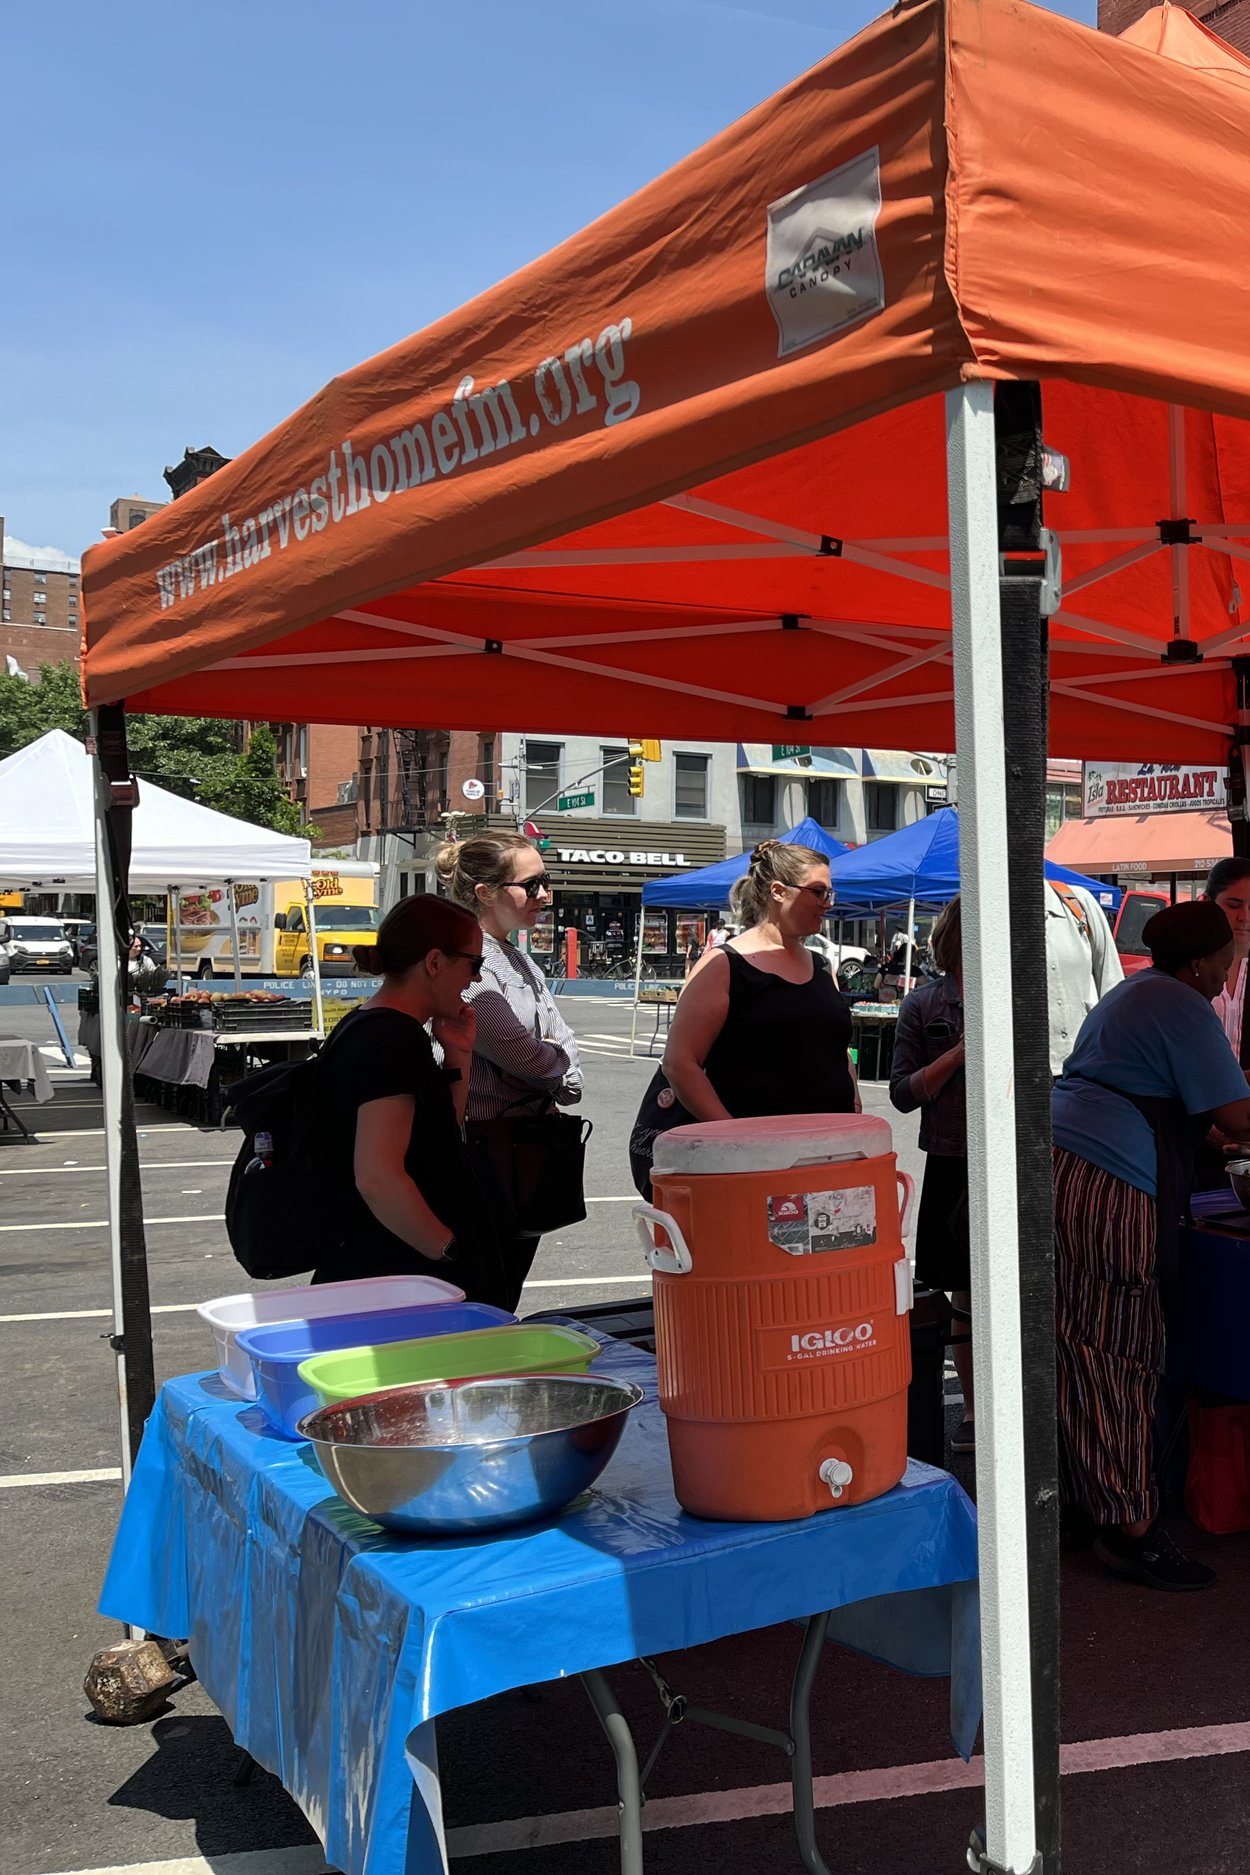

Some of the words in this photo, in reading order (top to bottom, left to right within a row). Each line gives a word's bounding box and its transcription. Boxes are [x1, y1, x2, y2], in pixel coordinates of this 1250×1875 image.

[790, 260, 852, 299] CANOPY
[156, 317, 640, 610] www.harvesthomefm.org
[1106, 771, 1218, 805] RESTAURANT
[557, 848, 626, 864] TACO
[628, 851, 692, 866] BELL
[1112, 863, 1130, 872] LATIN
[1130, 862, 1147, 871] FOOD
[316, 879, 338, 890] Old
[314, 888, 344, 900] yme
[614, 982, 637, 990] POLIC
[791, 1322, 873, 1353] IGLOO
[816, 1344, 854, 1357] DRINKING
